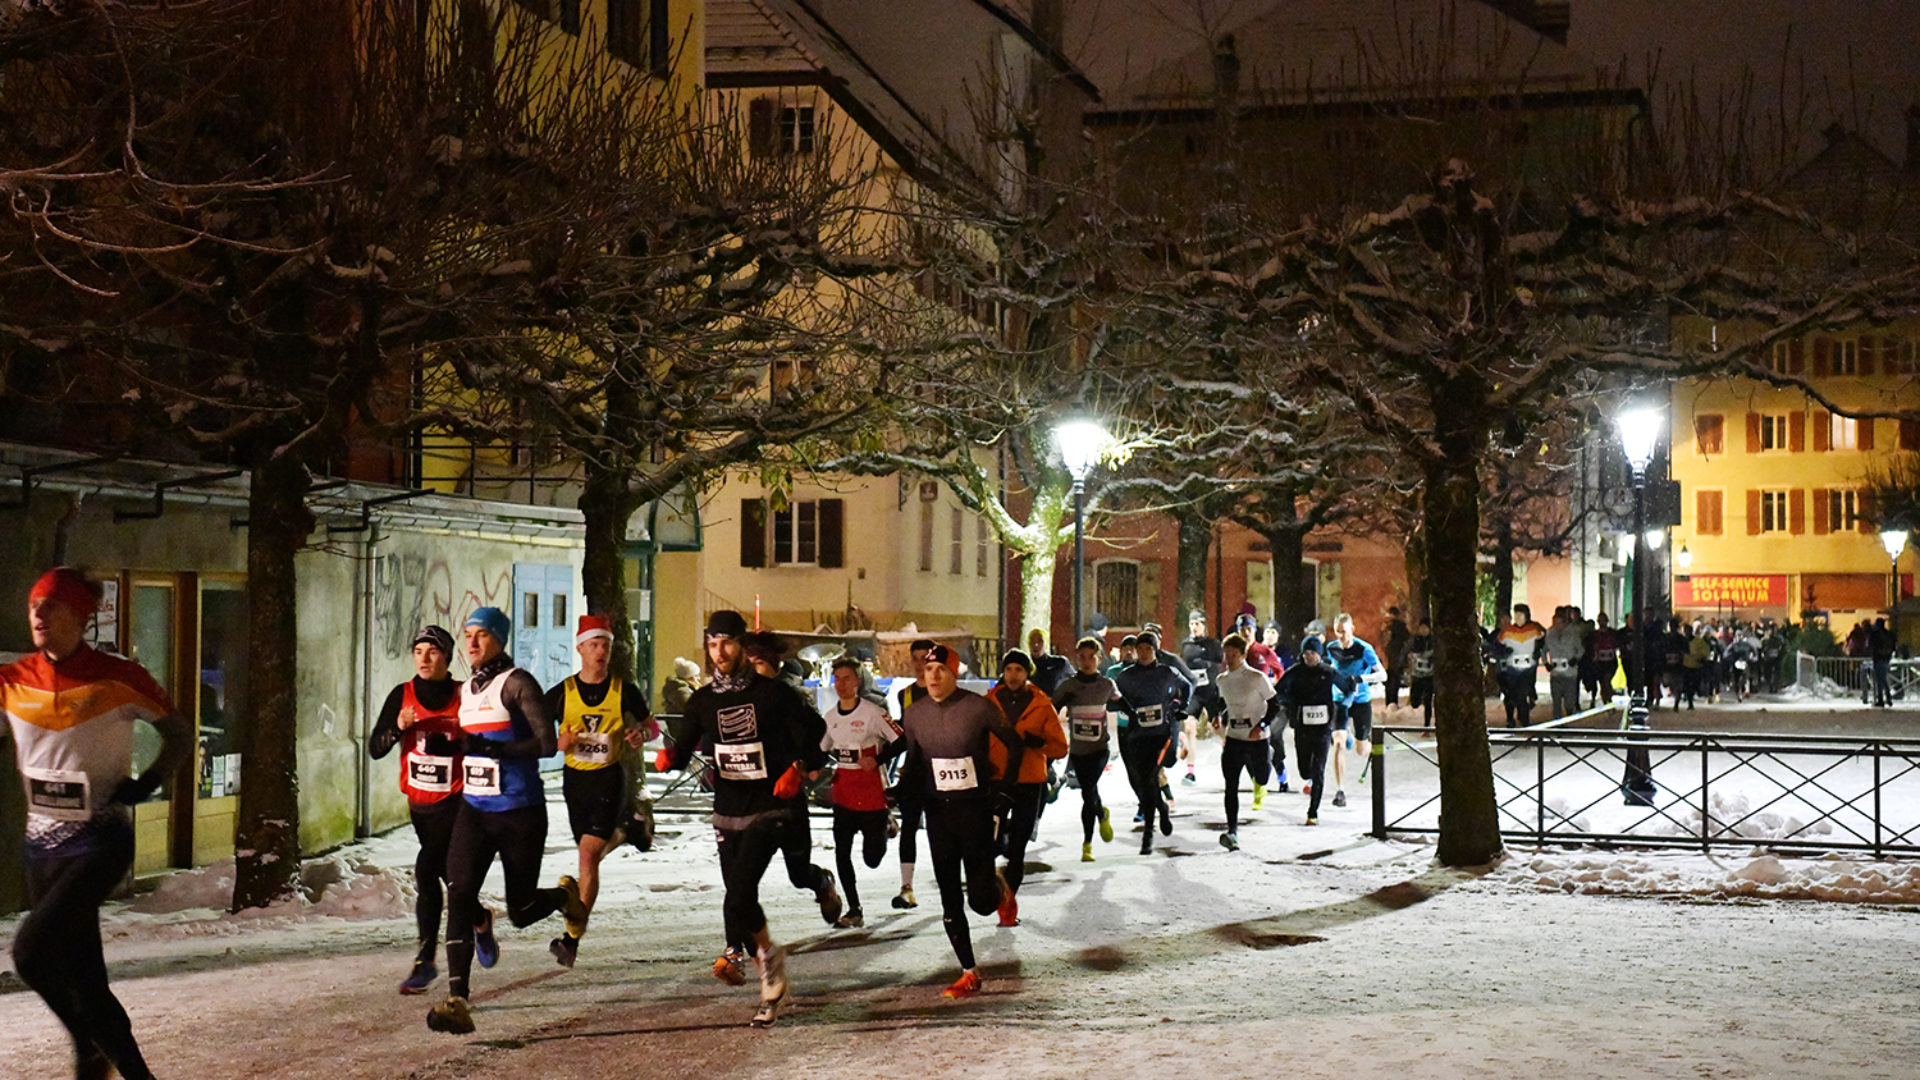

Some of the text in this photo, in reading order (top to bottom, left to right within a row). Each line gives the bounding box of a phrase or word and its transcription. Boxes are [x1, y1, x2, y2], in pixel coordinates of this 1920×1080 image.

[1691, 577, 1770, 590] SELF-SERVICE
[1692, 589, 1769, 602] SOLARIUM
[578, 743, 609, 753] 9268
[729, 753, 749, 762] 294
[417, 764, 437, 774] 640
[939, 768, 969, 781] 9113
